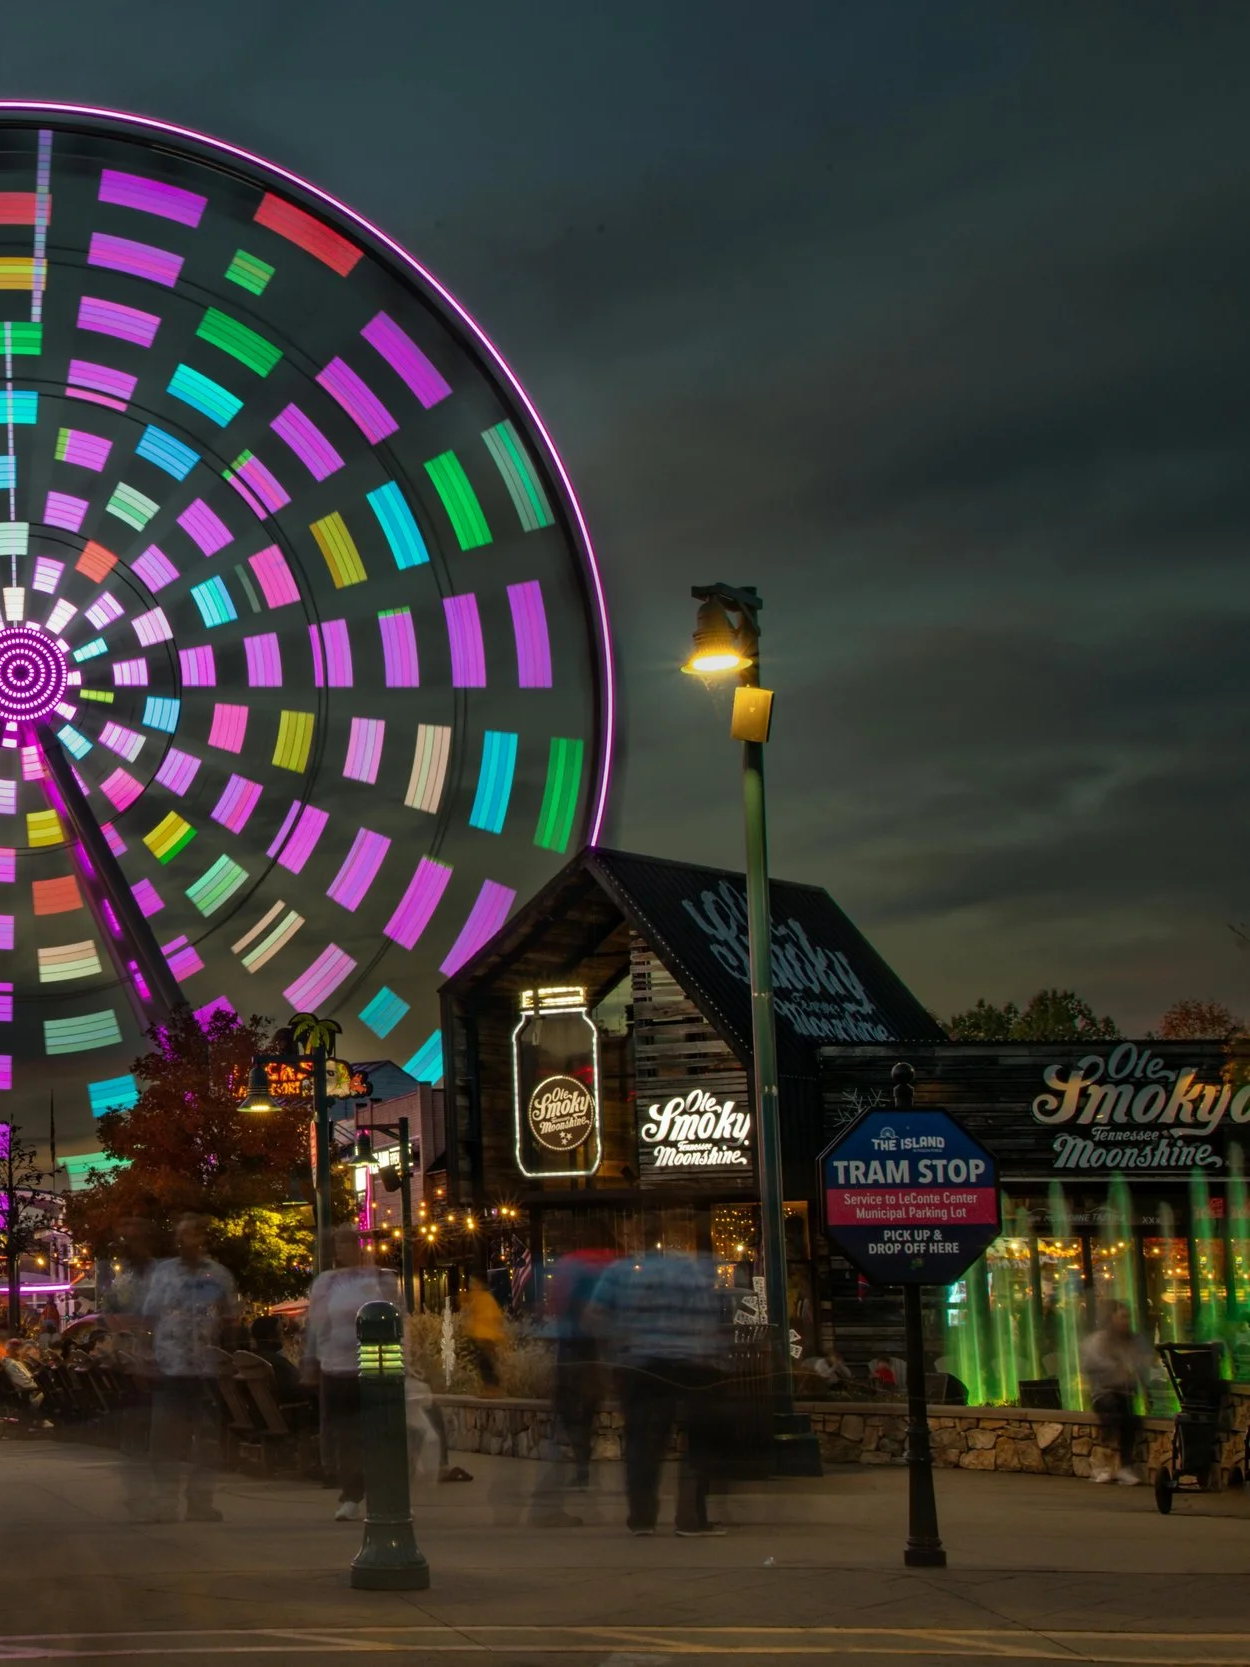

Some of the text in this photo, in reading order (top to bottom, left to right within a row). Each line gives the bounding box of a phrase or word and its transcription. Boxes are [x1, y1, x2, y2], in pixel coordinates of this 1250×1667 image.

[1107, 1042, 1177, 1082] Ole
[552, 1087, 573, 1102] Ole
[684, 1089, 722, 1113] Ole
[1031, 1055, 1232, 1138] Smoky
[532, 1090, 591, 1121] Smoky
[539, 1115, 590, 1135] Moonshine
[641, 1097, 750, 1147] Smoky
[871, 1136, 945, 1151] THE ISLAND
[1091, 1126, 1160, 1141] Tennessee
[653, 1144, 748, 1167] Moonshine
[677, 1140, 713, 1151] Tennessee
[1052, 1133, 1224, 1169] Moonshine
[833, 1159, 986, 1185] TRAM STOP
[844, 1191, 978, 1206] Service to LeConte Center
[856, 1206, 967, 1221] Municipal Parking Lot
[884, 1229, 943, 1241] PICK UP &
[868, 1242, 960, 1254] DROP OFF HERE
